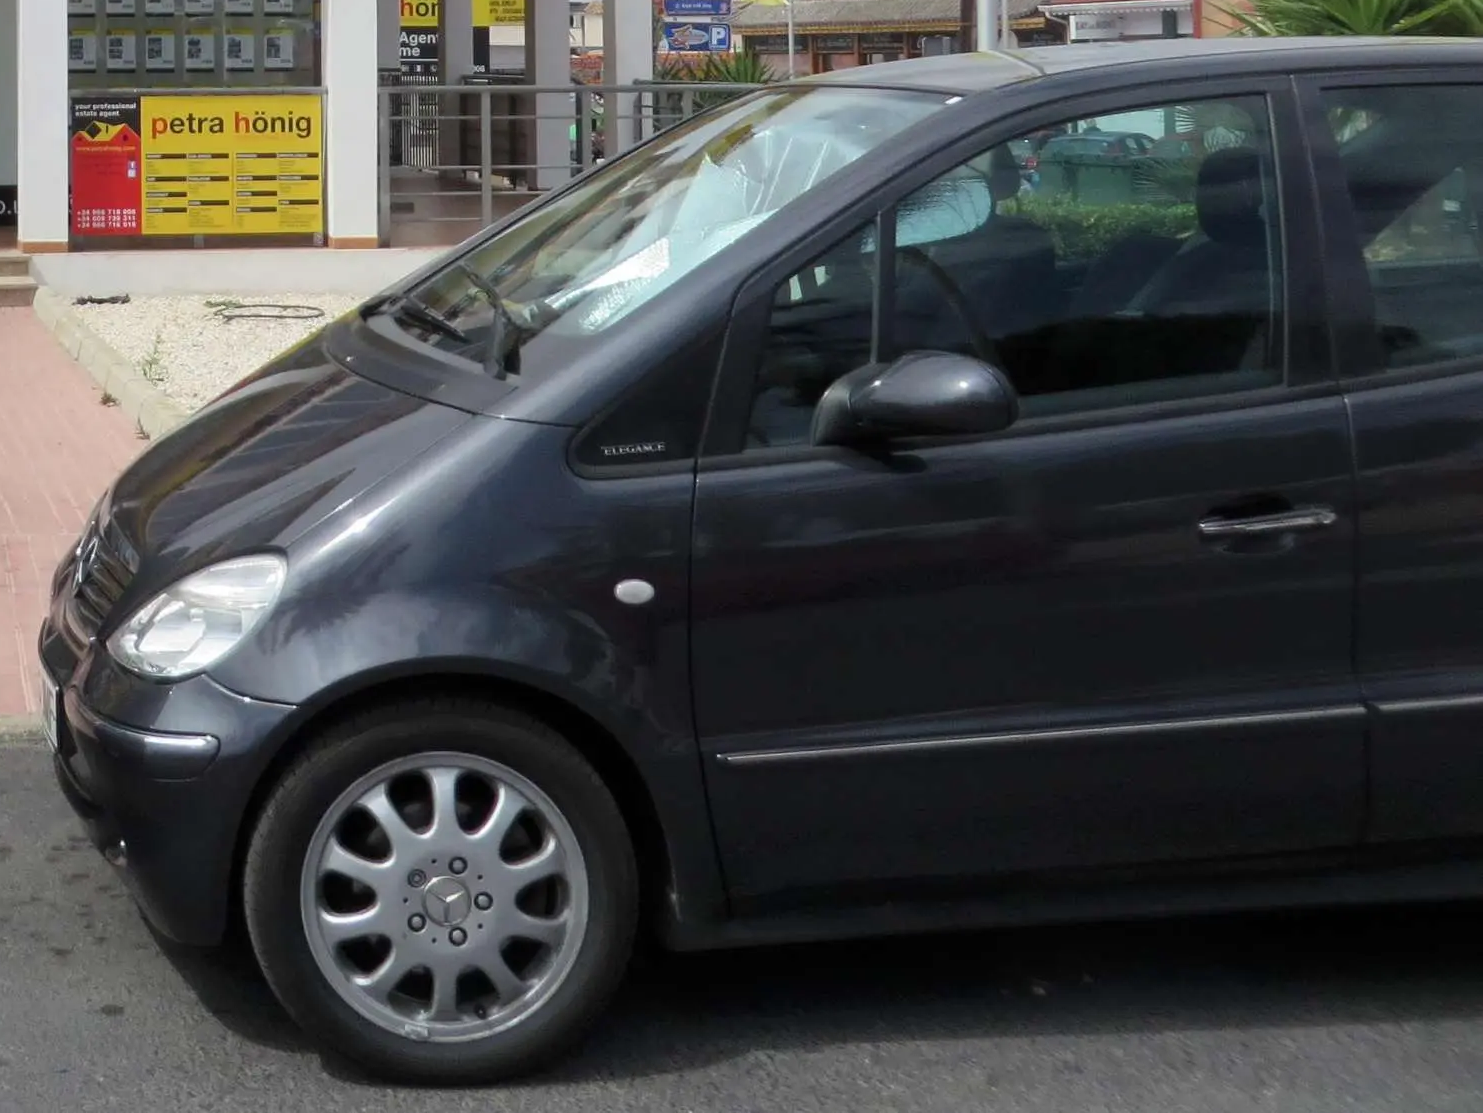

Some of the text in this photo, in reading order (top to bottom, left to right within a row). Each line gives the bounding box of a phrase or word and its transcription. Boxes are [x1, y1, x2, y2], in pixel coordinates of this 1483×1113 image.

[711, 27, 727, 45] P
[151, 110, 312, 140] petra hönig
[604, 441, 666, 456] ELEGANCE
